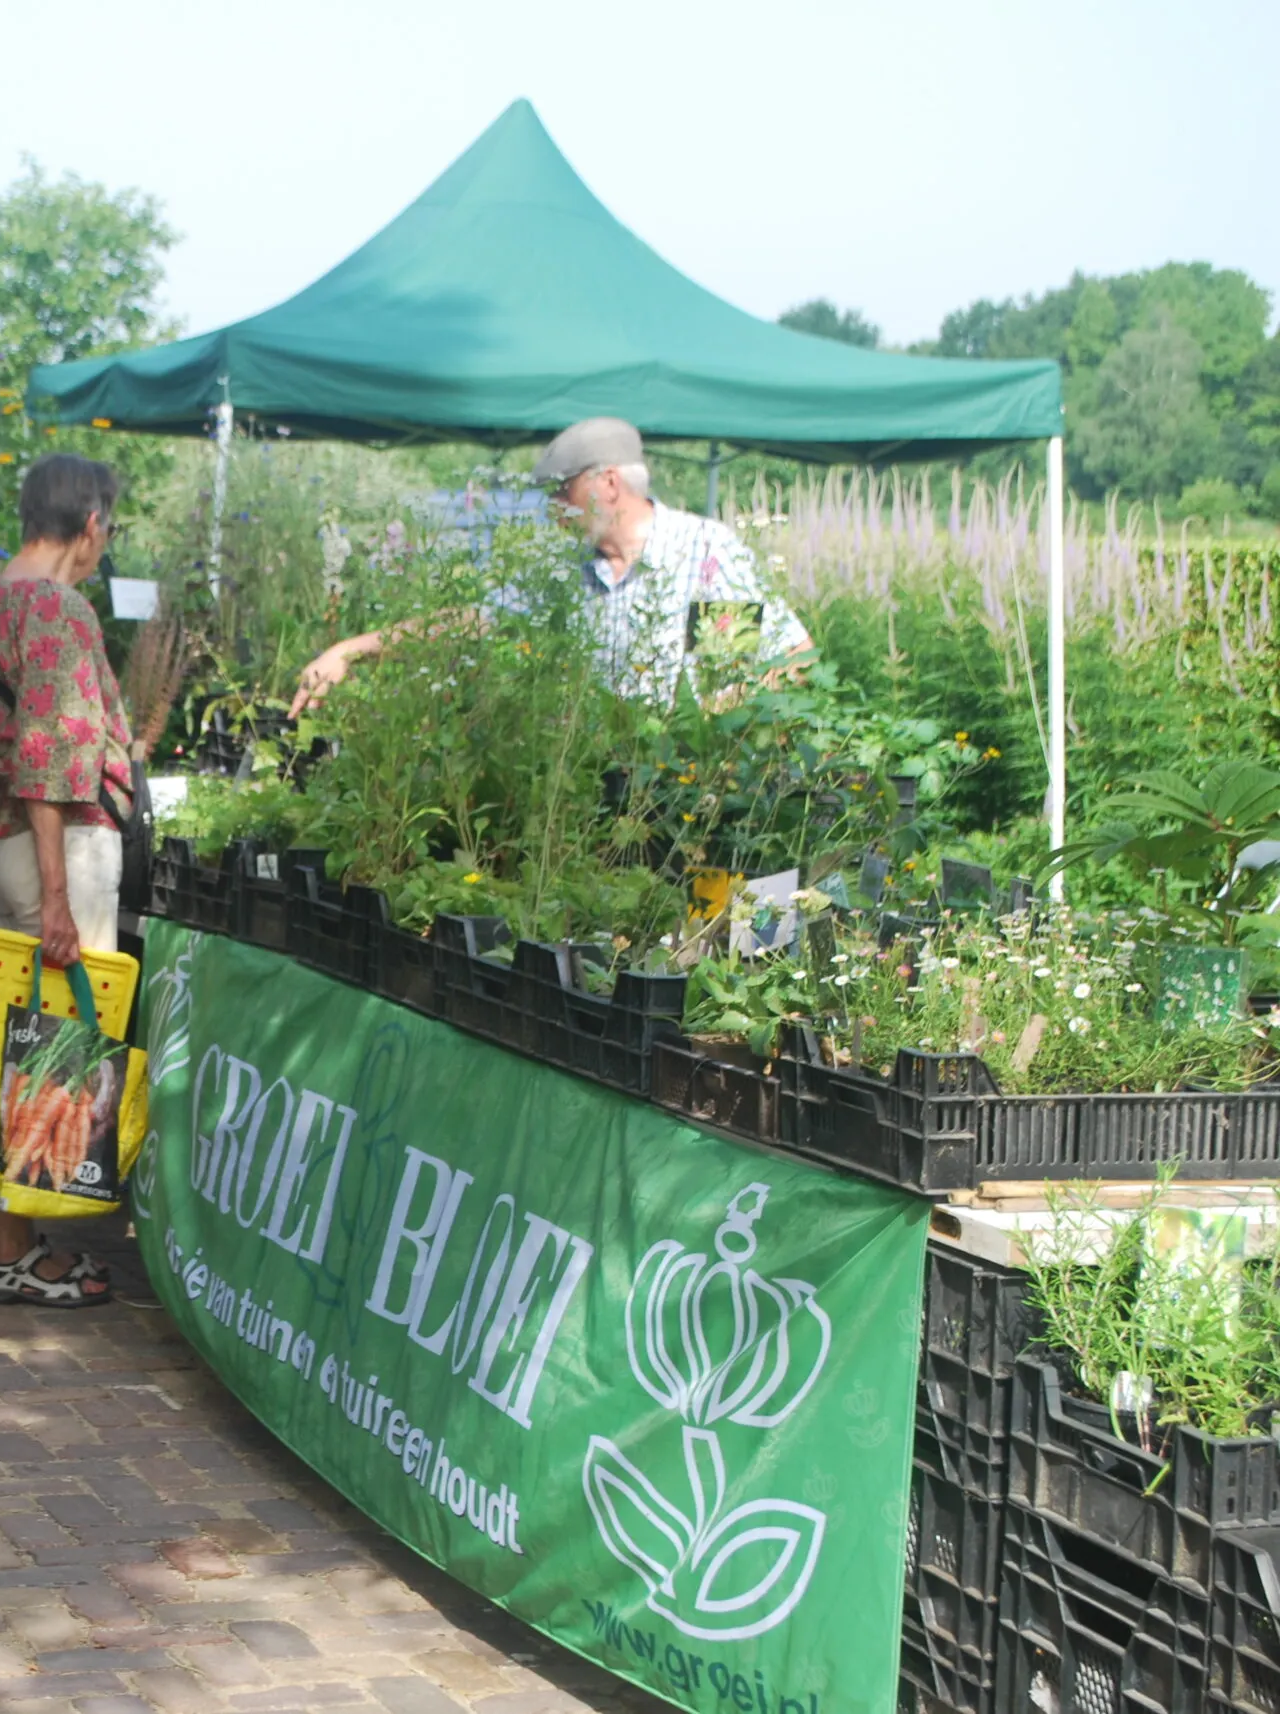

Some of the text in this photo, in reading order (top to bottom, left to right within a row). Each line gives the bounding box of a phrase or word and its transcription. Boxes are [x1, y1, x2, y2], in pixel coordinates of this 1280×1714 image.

[78, 1164, 98, 1181] M
[190, 1043, 358, 1264] GROEI
[365, 1144, 595, 1431] BLOEI
[205, 1272, 236, 1328] van
[430, 1438, 524, 1554] houdt
